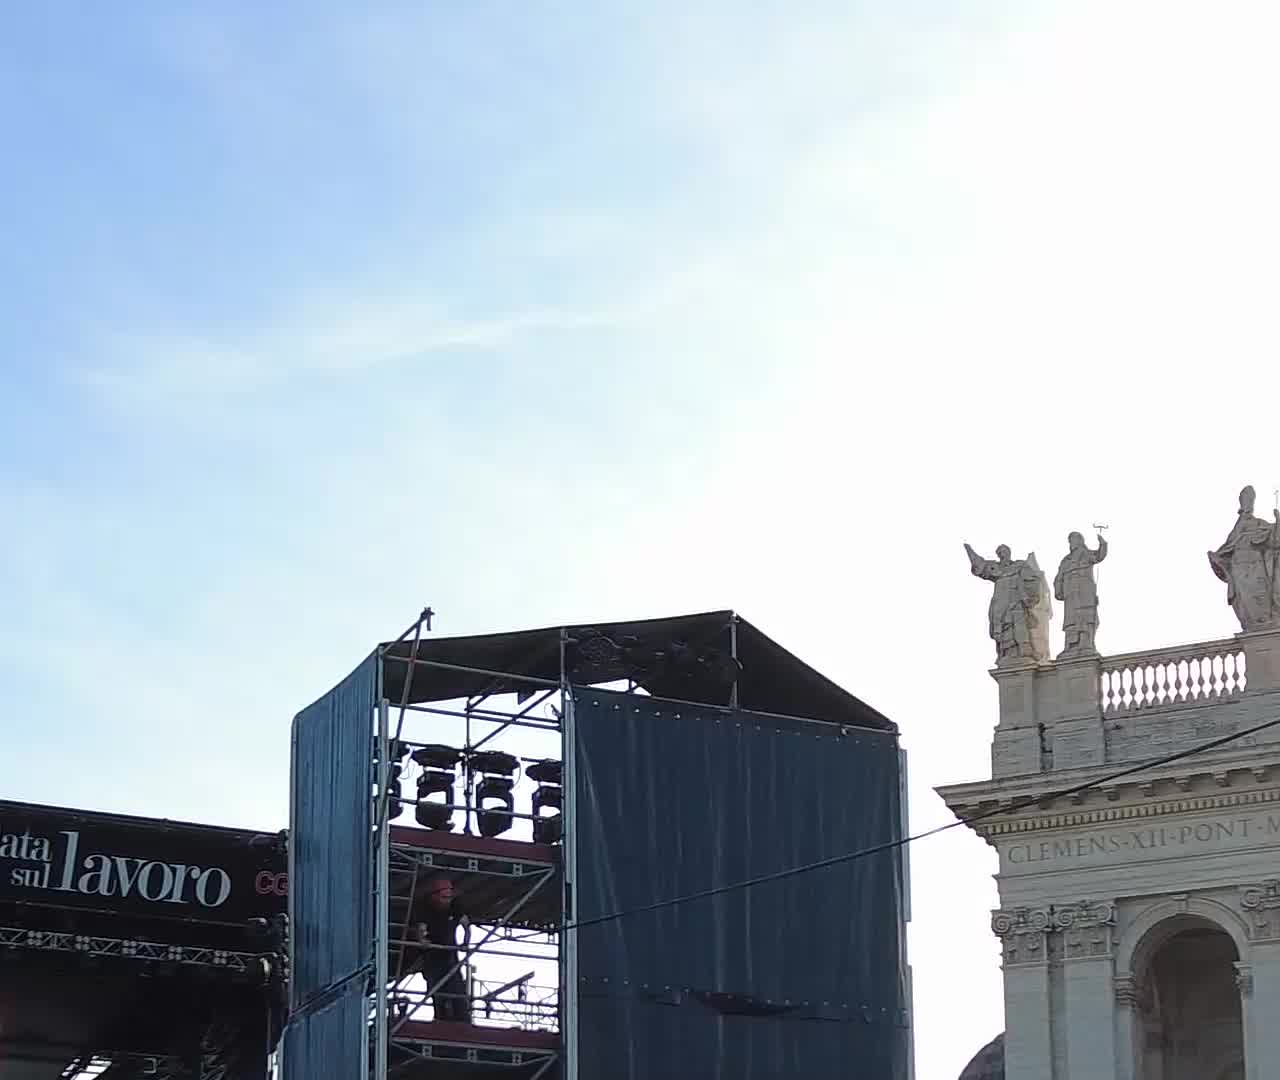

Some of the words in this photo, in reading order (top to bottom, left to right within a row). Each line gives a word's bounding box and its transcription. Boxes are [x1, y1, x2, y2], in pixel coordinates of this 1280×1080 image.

[1008, 835, 1120, 864] CLEMENS
[1128, 830, 1168, 852] XII
[1176, 821, 1251, 846] PONT
[11, 862, 52, 889] sul
[48, 830, 232, 907] lavoro
[256, 870, 288, 896] CG
